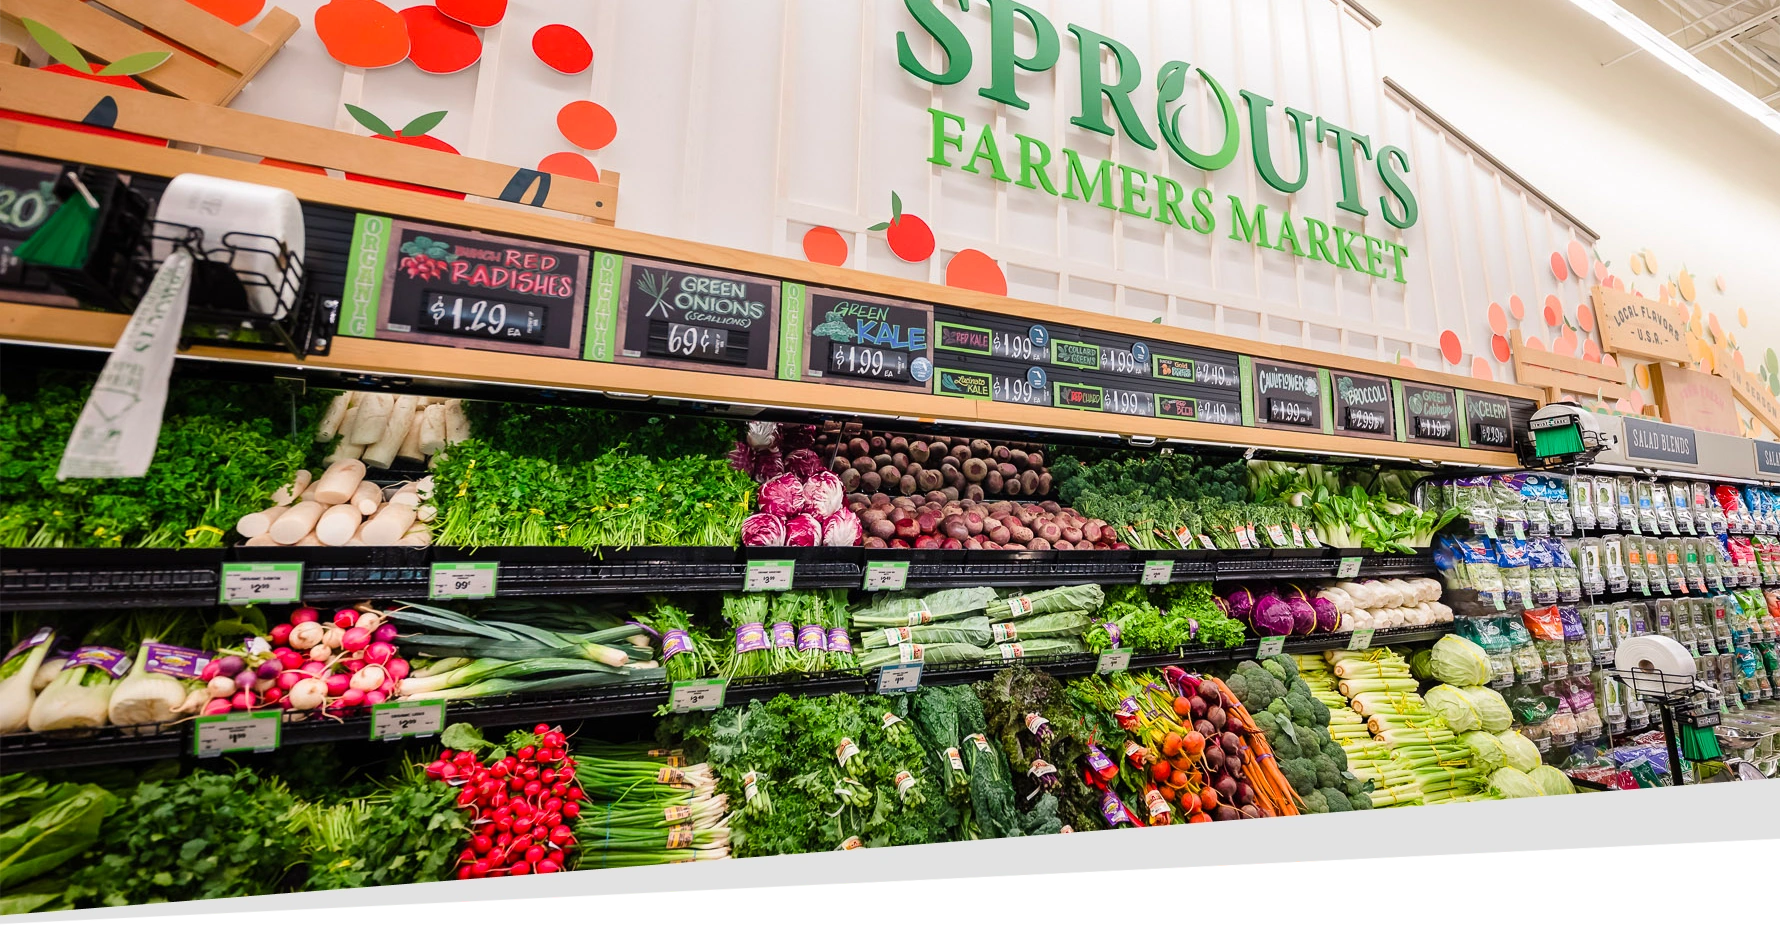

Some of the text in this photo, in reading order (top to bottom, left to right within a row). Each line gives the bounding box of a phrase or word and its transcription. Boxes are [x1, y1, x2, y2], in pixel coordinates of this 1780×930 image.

[896, 0, 1418, 229] SPROUTS
[926, 107, 1410, 285] FARMERS MARKET
[504, 248, 559, 273] RED
[350, 216, 383, 336] ORGANIC
[450, 259, 573, 298] RADISHES
[679, 275, 748, 300] GREEN
[429, 294, 507, 336] $1.29
[507, 327, 522, 337] EA
[592, 253, 616, 360] ORGANIC
[673, 291, 766, 321] ONIONS
[833, 301, 890, 322] GREEN
[684, 310, 752, 329] (SCALLIONS)
[785, 284, 800, 380] ORGANIC
[1613, 304, 1680, 342] LOCAL FLAVORS
[667, 324, 711, 356] 69¢
[856, 318, 928, 352] KALE
[955, 332, 988, 348] RED KALE
[993, 332, 1032, 360] $1.99
[835, 345, 884, 377] $1.99
[1067, 345, 1097, 356] COLLARD
[1070, 353, 1097, 366] GREENS
[1100, 348, 1135, 374] $1.99
[1174, 361, 1189, 370] Gold
[1196, 363, 1226, 386] $2.49
[953, 375, 986, 387] Lacinato
[967, 384, 989, 396] KALE
[993, 376, 1032, 404] $1.99
[1259, 366, 1305, 395] CAULIFLOWER
[1070, 390, 1101, 404] RED CHARD
[1104, 389, 1138, 415] $1.99
[1346, 384, 1388, 406] BROCCOLI
[1422, 389, 1447, 403] GREEN
[1197, 400, 1227, 424] $2.49
[1271, 400, 1301, 422] $1.99
[1350, 409, 1374, 430] $2.99
[1422, 401, 1454, 419] Cabbage
[1478, 399, 1507, 420] CELERY
[1632, 428, 1690, 456] SALAD BLENDS
